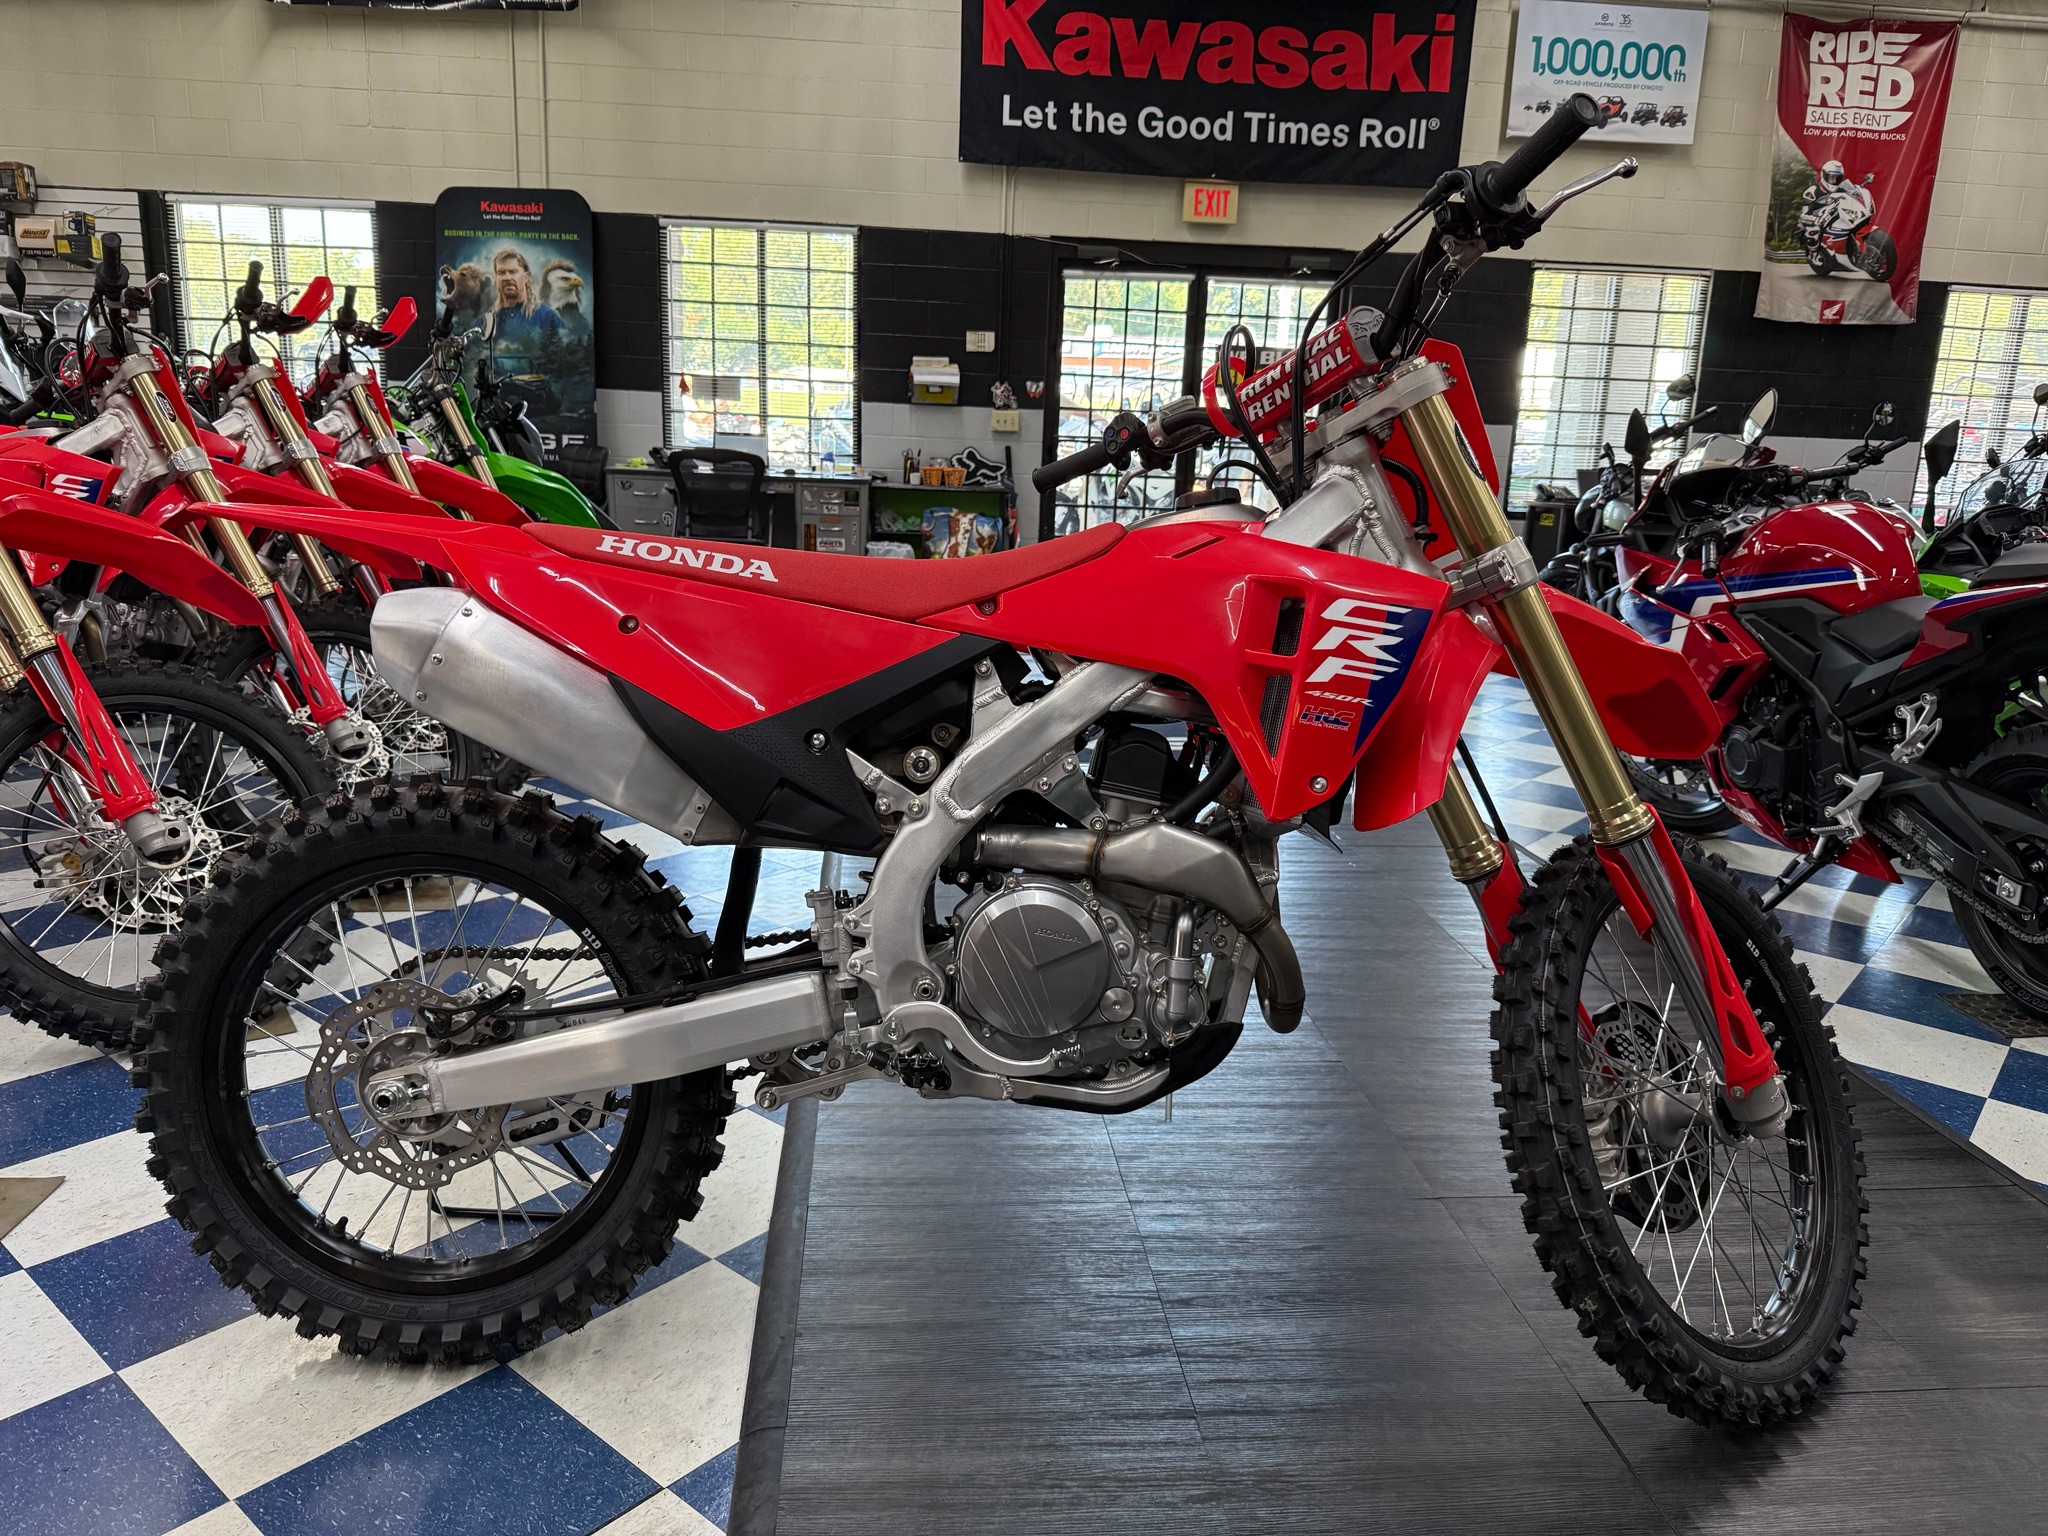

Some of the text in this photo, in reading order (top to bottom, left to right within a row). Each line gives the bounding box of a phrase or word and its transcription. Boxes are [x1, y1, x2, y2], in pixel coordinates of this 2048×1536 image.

[982, 0, 1455, 93] Kawasaki
[1810, 31, 1922, 65] RIDE
[1553, 79, 1581, 87] OFF-ROAD
[1583, 80, 1603, 88] VEHICLE
[1603, 81, 1633, 90] PRODUCED
[1807, 62, 1915, 110] RED
[1001, 94, 1058, 132] Let
[1070, 102, 1128, 136] the
[1137, 106, 1234, 142] Good
[1243, 111, 1350, 148] Times
[1810, 110, 1892, 127] SALES EVENT
[1803, 127, 1906, 141] LOW APR AND BONUS BUCKS
[480, 201, 543, 214] Kawasaki
[1193, 188, 1231, 218] EXIT
[444, 229, 474, 237] BUSINESS
[483, 230, 495, 238] THE
[540, 232, 548, 240] IN
[1248, 346, 1351, 422] RENHAL
[596, 534, 779, 582] HONDA
[1304, 690, 1375, 708] 450R
[1034, 928, 1083, 944] HONDA
